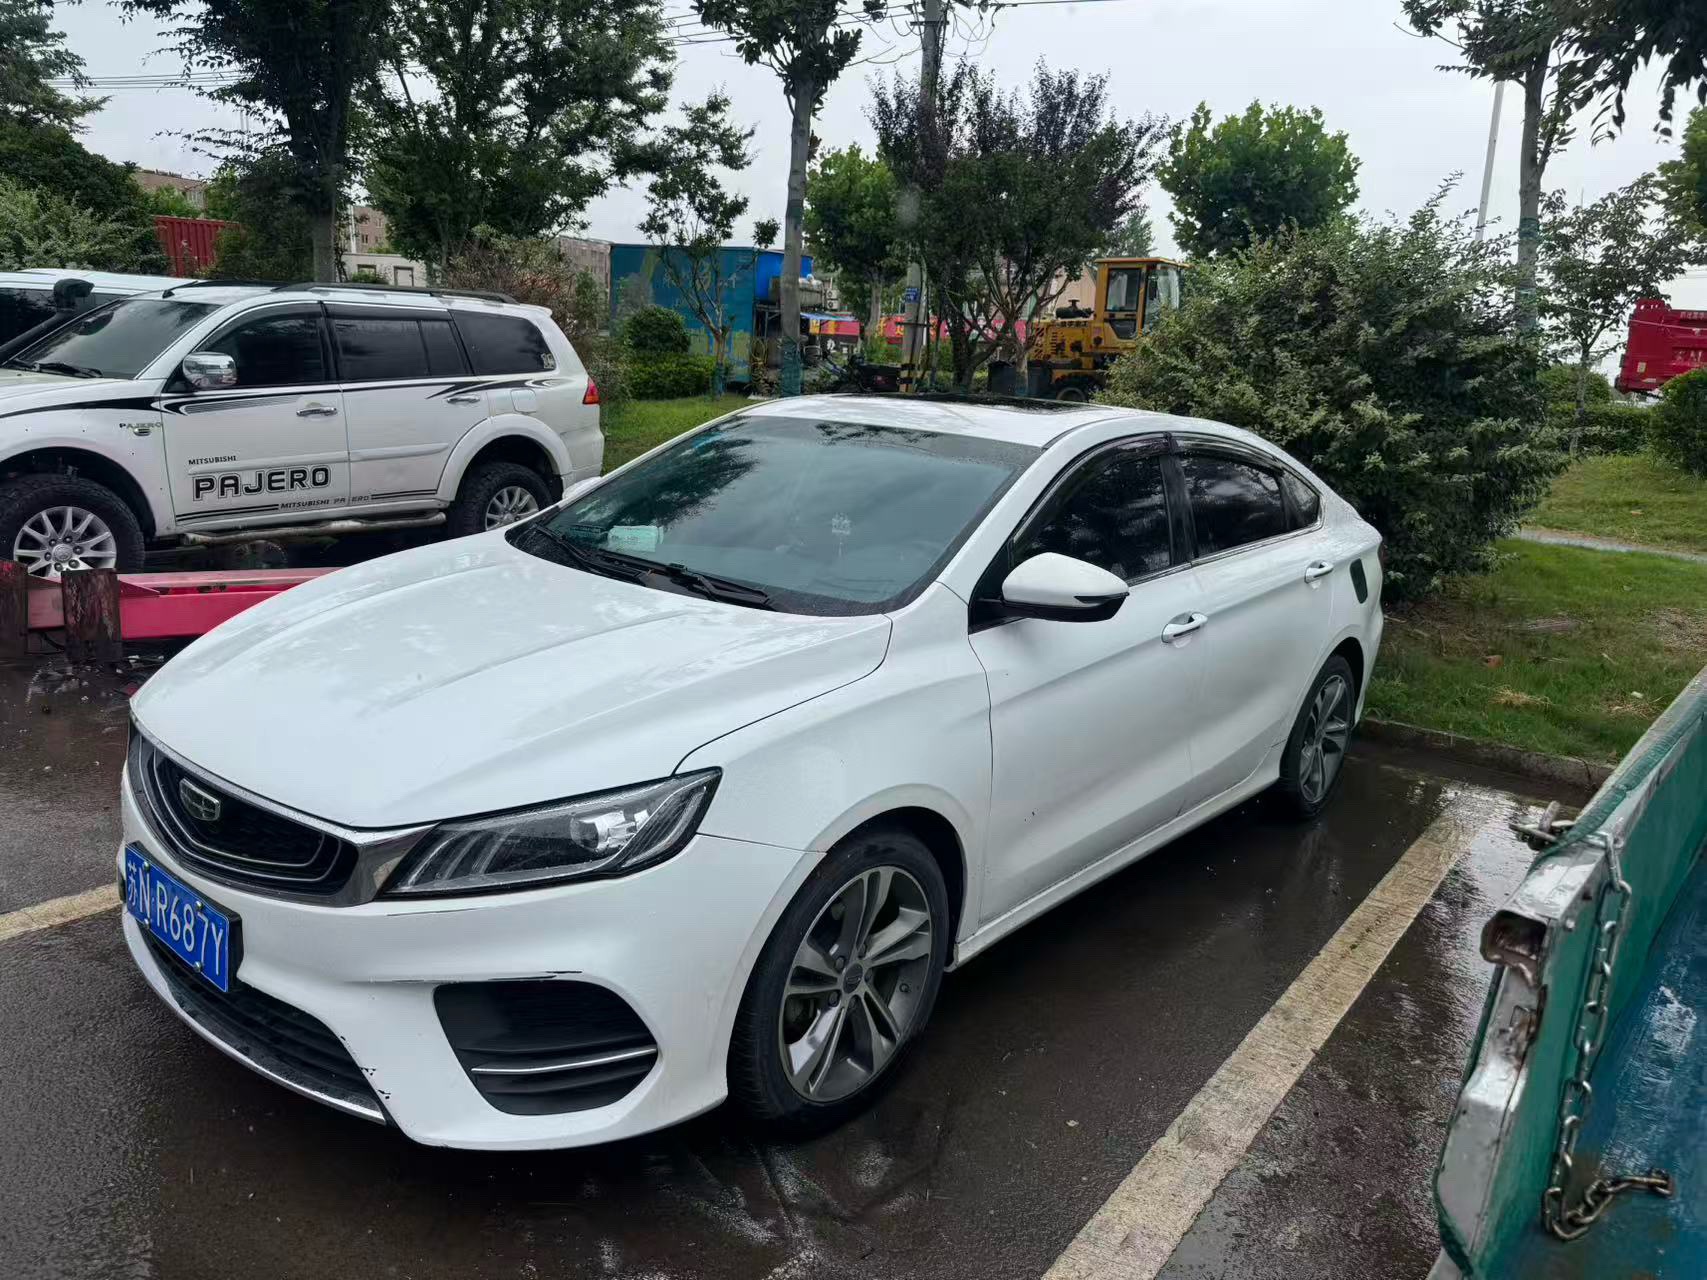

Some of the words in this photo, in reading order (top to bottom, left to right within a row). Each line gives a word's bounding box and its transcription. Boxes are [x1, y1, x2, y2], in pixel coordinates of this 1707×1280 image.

[188, 455, 237, 465] MITSUBISHI
[193, 465, 331, 501] PAJERO
[280, 499, 330, 509] MITSUBISHI
[333, 494, 370, 507] PAERO
